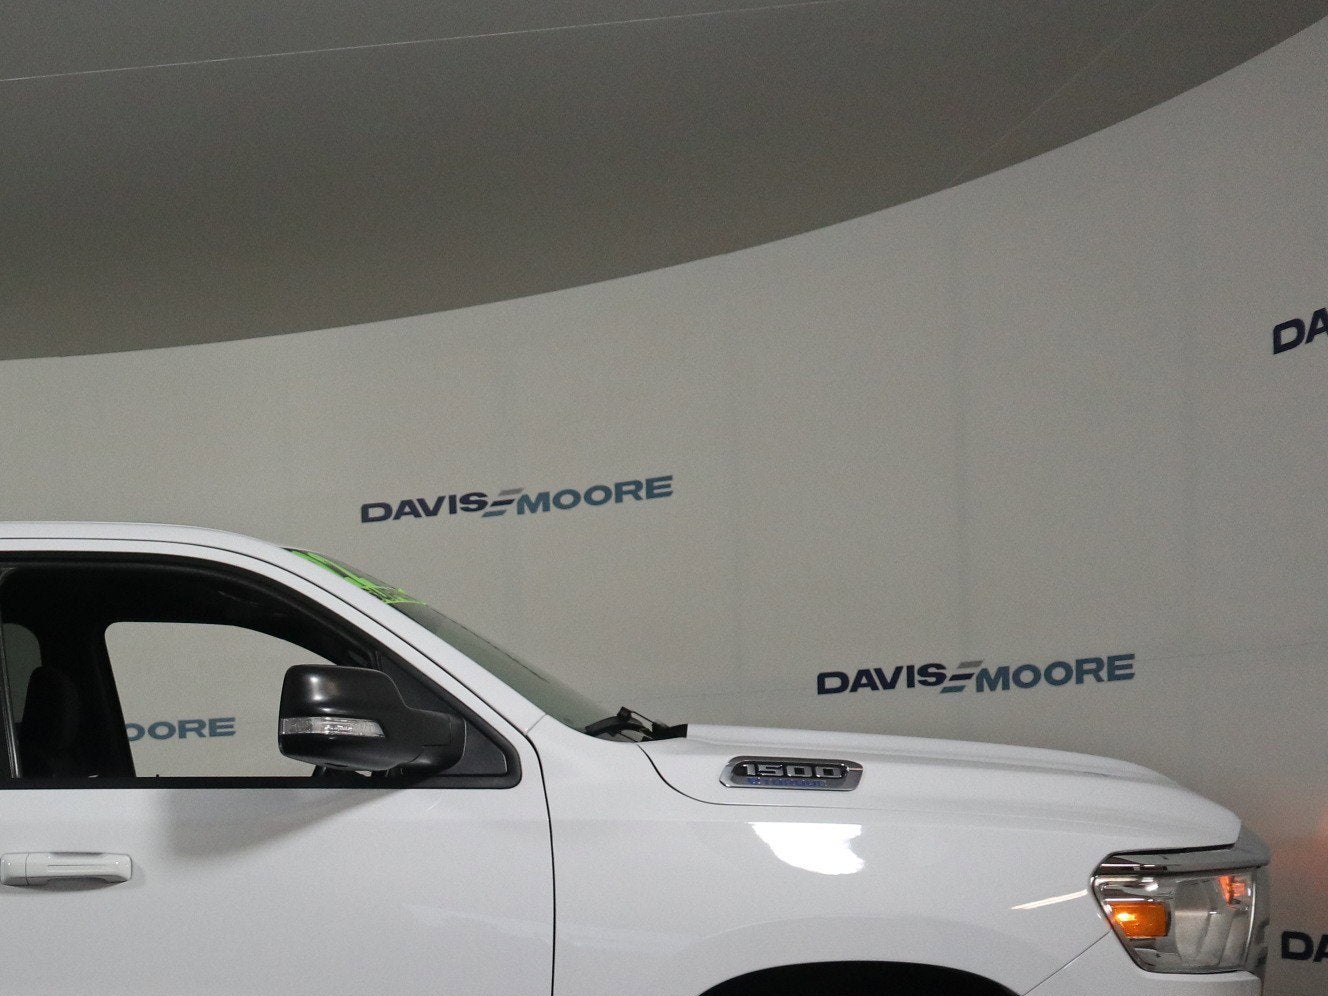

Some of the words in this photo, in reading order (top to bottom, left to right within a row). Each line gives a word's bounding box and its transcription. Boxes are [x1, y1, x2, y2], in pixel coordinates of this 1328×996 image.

[361, 492, 489, 523] DAVIS
[516, 475, 673, 515] MOORE
[816, 663, 947, 695] DAVIS
[975, 653, 1135, 692] MOORE
[125, 717, 236, 741] OORE
[741, 762, 845, 778] 1500
